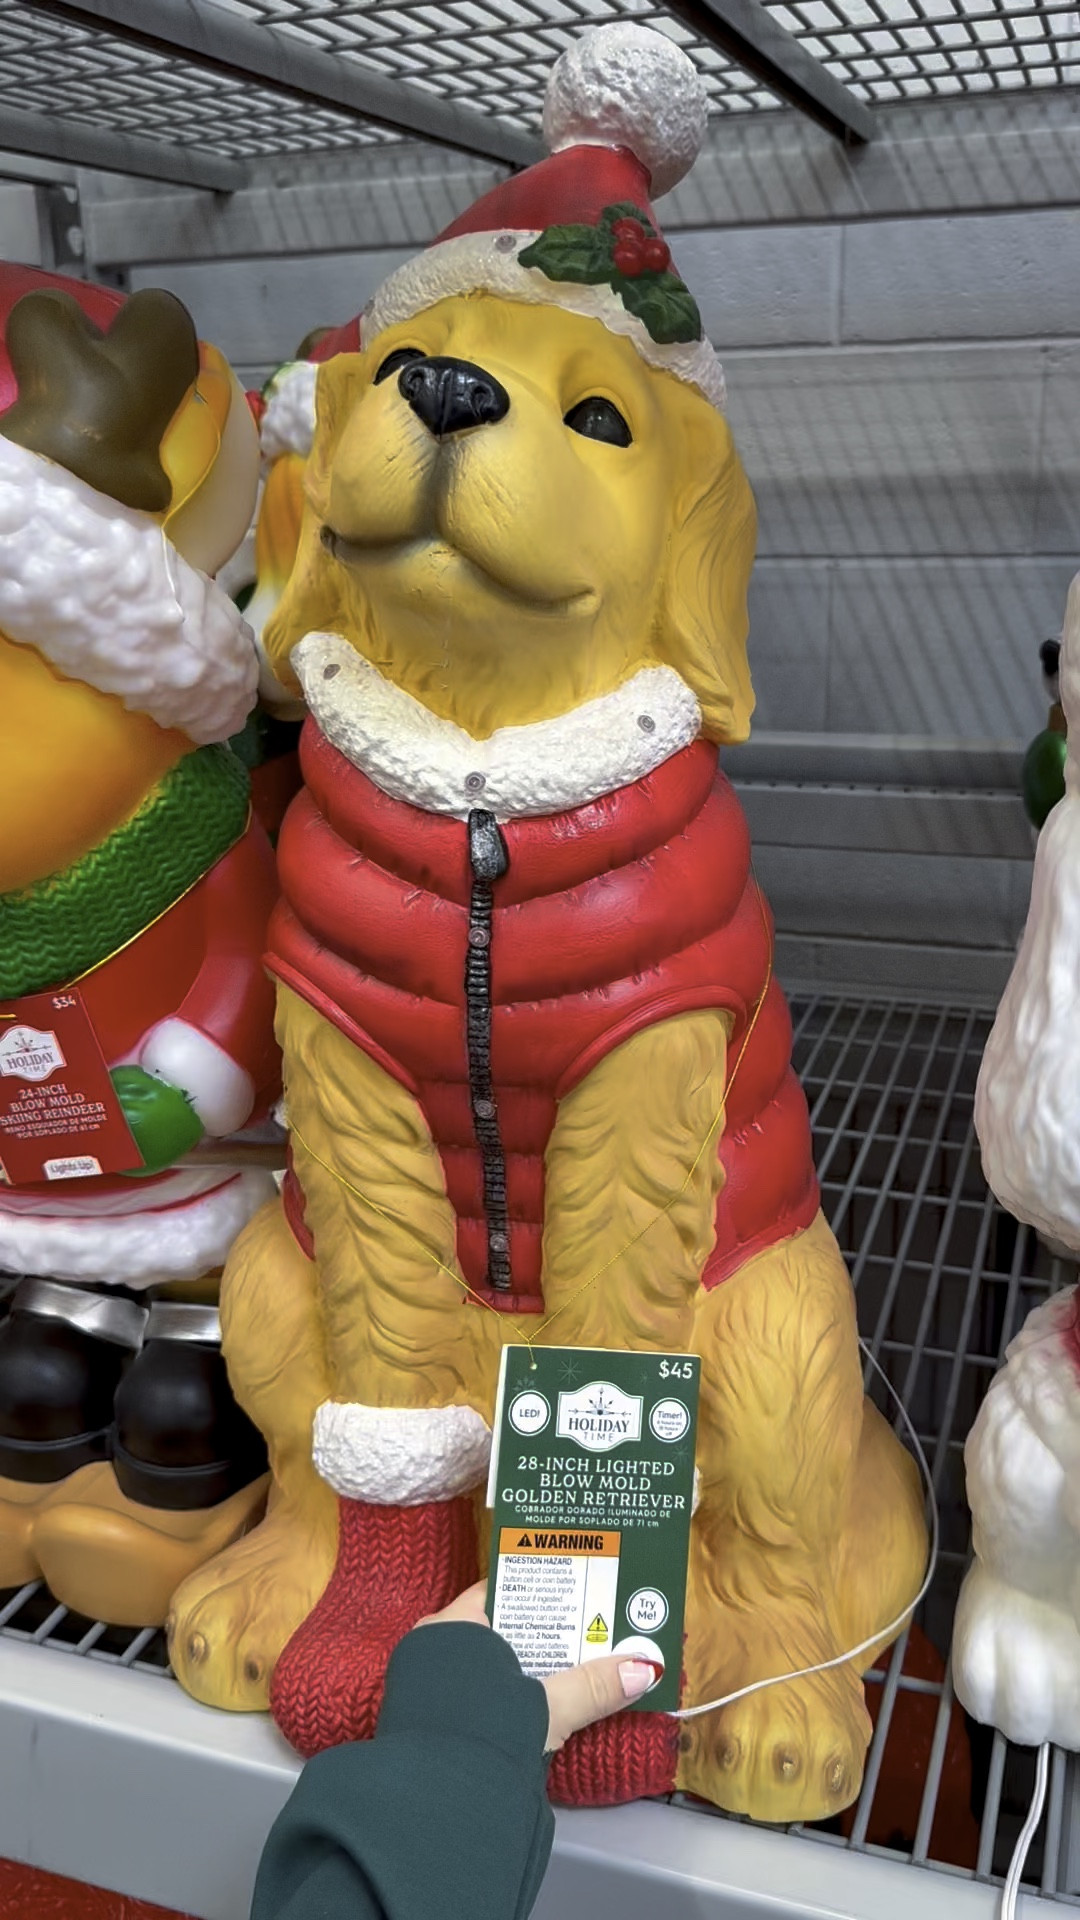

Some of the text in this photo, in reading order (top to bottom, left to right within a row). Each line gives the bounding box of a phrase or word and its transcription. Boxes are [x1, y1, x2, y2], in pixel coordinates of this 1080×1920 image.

[52, 995, 77, 1009] $34
[6, 1052, 55, 1070] HOLIDAY
[23, 1064, 47, 1073] TIME
[18, 1083, 68, 1099] 24-INCH
[10, 1093, 85, 1113] BLOW MOLD
[0, 1102, 106, 1126] SKIING REINDEER
[80, 1113, 108, 1122] MOLDE
[659, 1359, 693, 1379] $45
[519, 1408, 541, 1418] LED!
[657, 1411, 682, 1419] Timer!
[568, 1417, 630, 1433] HOLIDAY
[583, 1432, 614, 1442] TIME
[517, 1456, 675, 1476] 28-INCH LIGHTED
[540, 1473, 651, 1491] BLOW MOLD
[501, 1488, 685, 1509] GOLDEN RETRIEVER
[515, 1504, 564, 1514] COBRADOR
[567, 1506, 605, 1515] DORADO
[608, 1508, 657, 1517] ILUMINADO
[525, 1515, 556, 1524] MOLDE
[558, 1516, 576, 1524] POR
[579, 1517, 620, 1526] SOPLADO
[636, 1519, 645, 1527] 71
[534, 1533, 604, 1550] WARNING
[504, 1556, 572, 1565] INGESTION HAZARD
[505, 1565, 517, 1573] This
[518, 1566, 541, 1575] product
[542, 1567, 567, 1575] contains
[503, 1575, 522, 1583] button
[556, 1576, 576, 1585] battery
[502, 1584, 526, 1592] DEATH
[558, 1586, 573, 1594] injury
[507, 1603, 538, 1611] swallowed
[540, 1604, 559, 1612] button
[639, 1598, 656, 1610] Try
[514, 1613, 535, 1622] battery
[637, 1610, 656, 1620] Me!
[499, 1622, 523, 1630] Internal
[525, 1622, 555, 1630] Chemical
[548, 1642, 569, 1650] batteries
